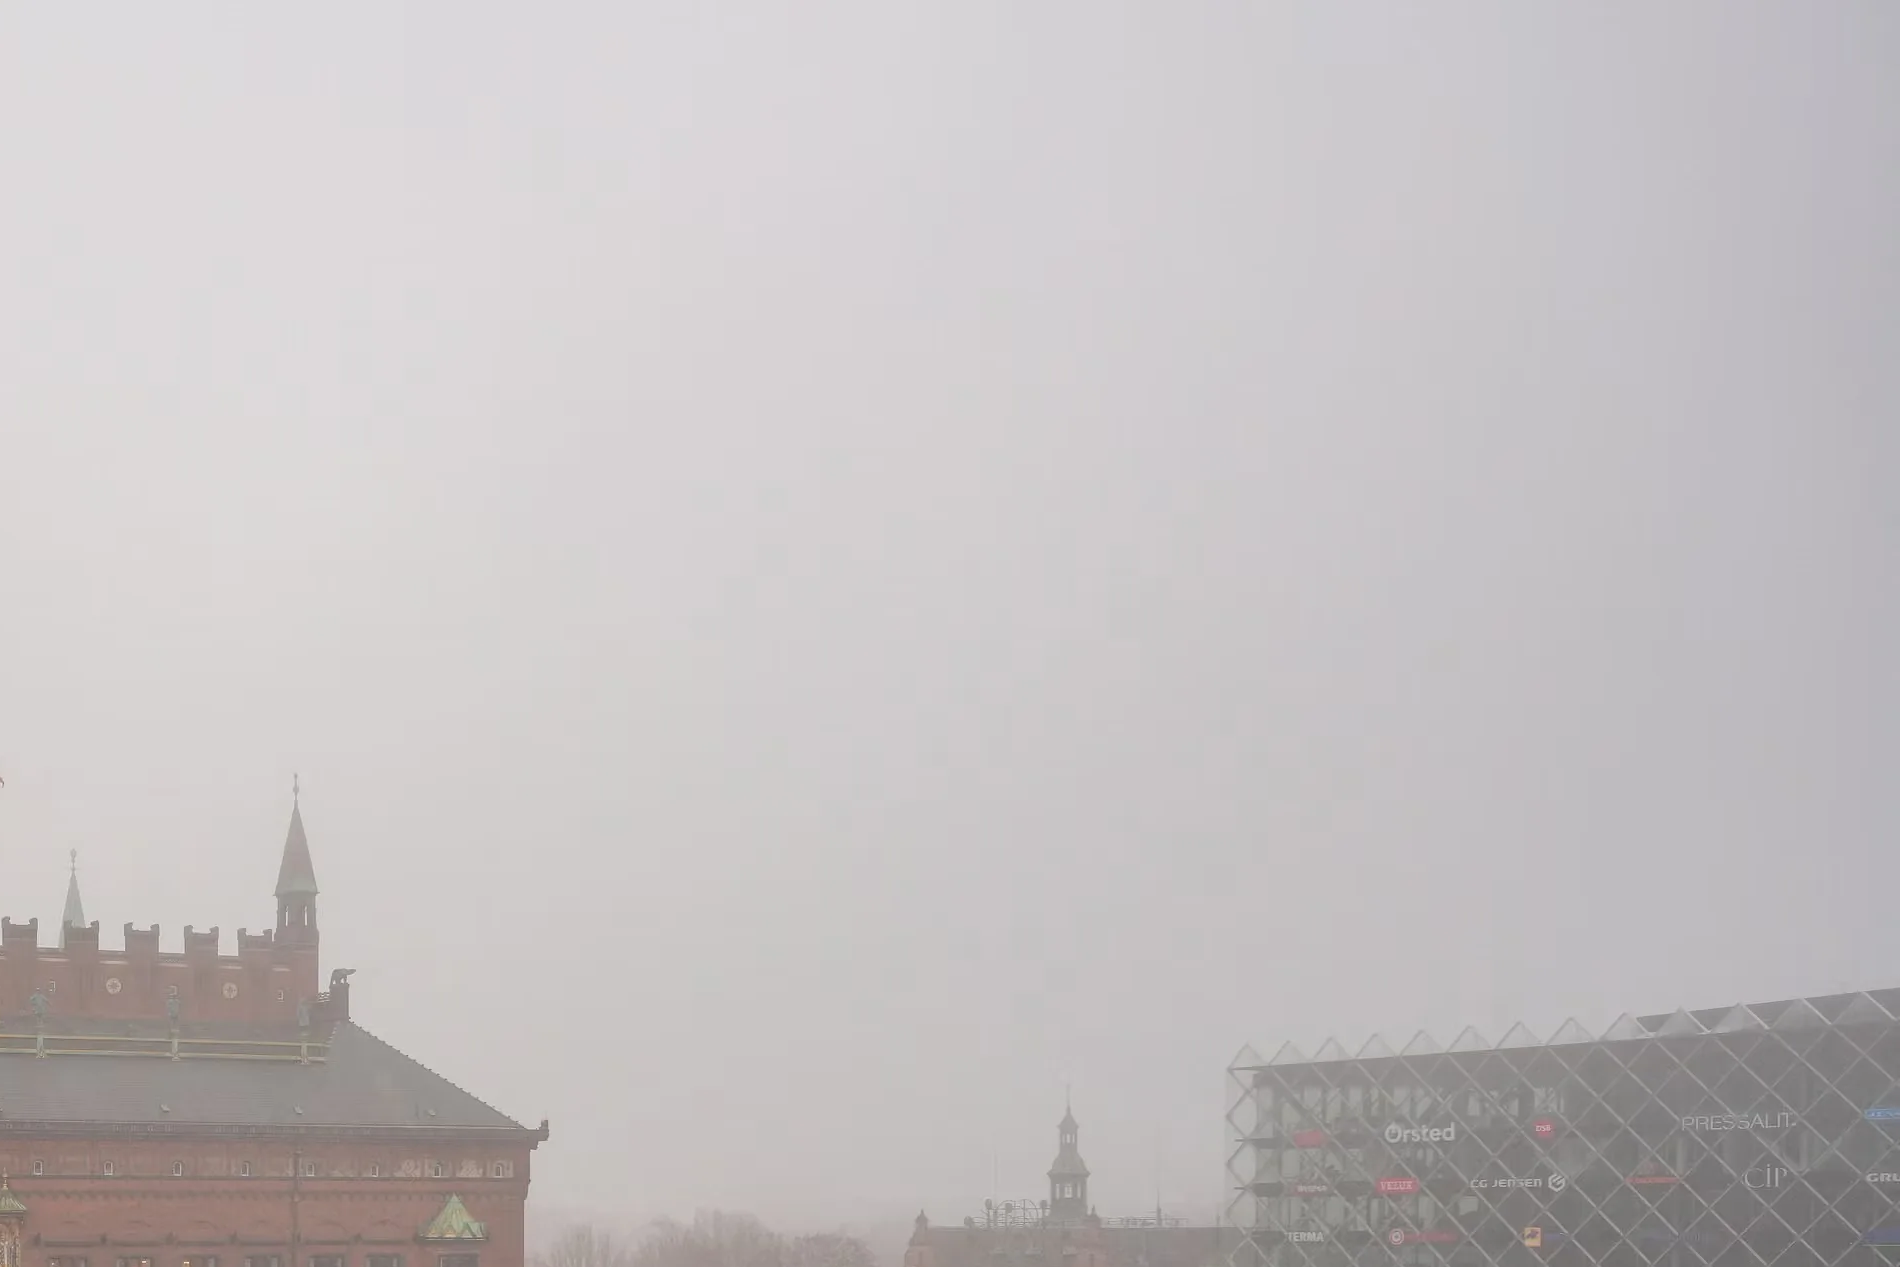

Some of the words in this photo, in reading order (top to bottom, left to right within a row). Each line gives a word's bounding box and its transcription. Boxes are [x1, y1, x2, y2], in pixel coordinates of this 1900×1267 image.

[1385, 1121, 1455, 1143] Ørsted
[1471, 1179, 1487, 1188] CG
[1492, 1178, 1542, 1188] JENSEN
[1287, 1231, 1324, 1242] TERMA
